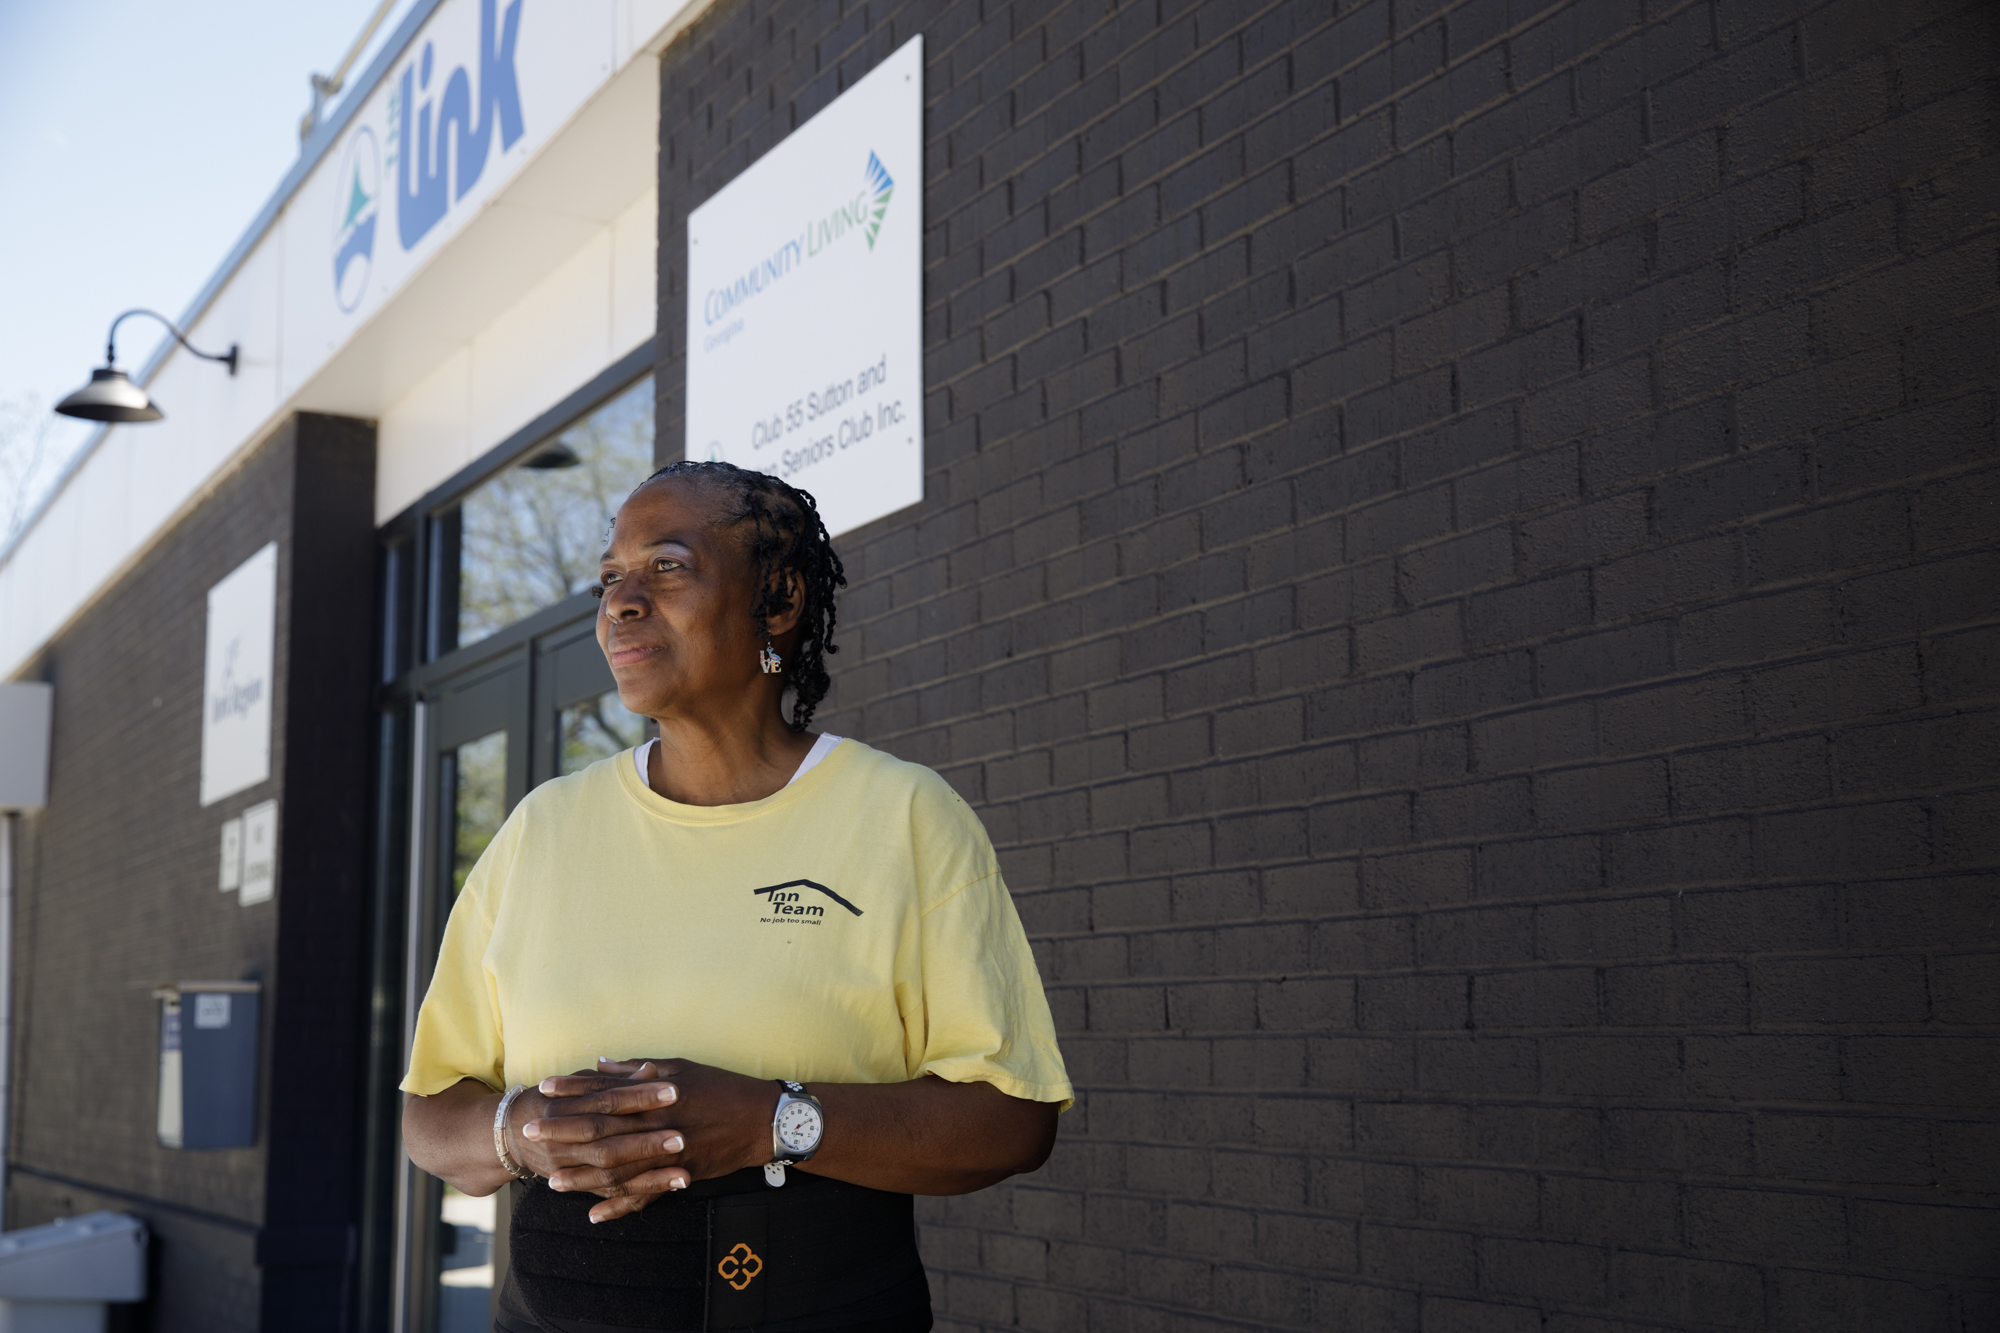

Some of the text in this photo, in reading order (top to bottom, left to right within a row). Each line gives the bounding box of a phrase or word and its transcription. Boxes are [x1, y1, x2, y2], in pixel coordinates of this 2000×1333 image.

[704, 189, 868, 327] COMMUNITY LIVING
[751, 352, 887, 450] Club 55 Sutton and
[782, 399, 907, 479] Seniors Club Inc.
[767, 889, 800, 902] Inn
[773, 901, 825, 917] Team
